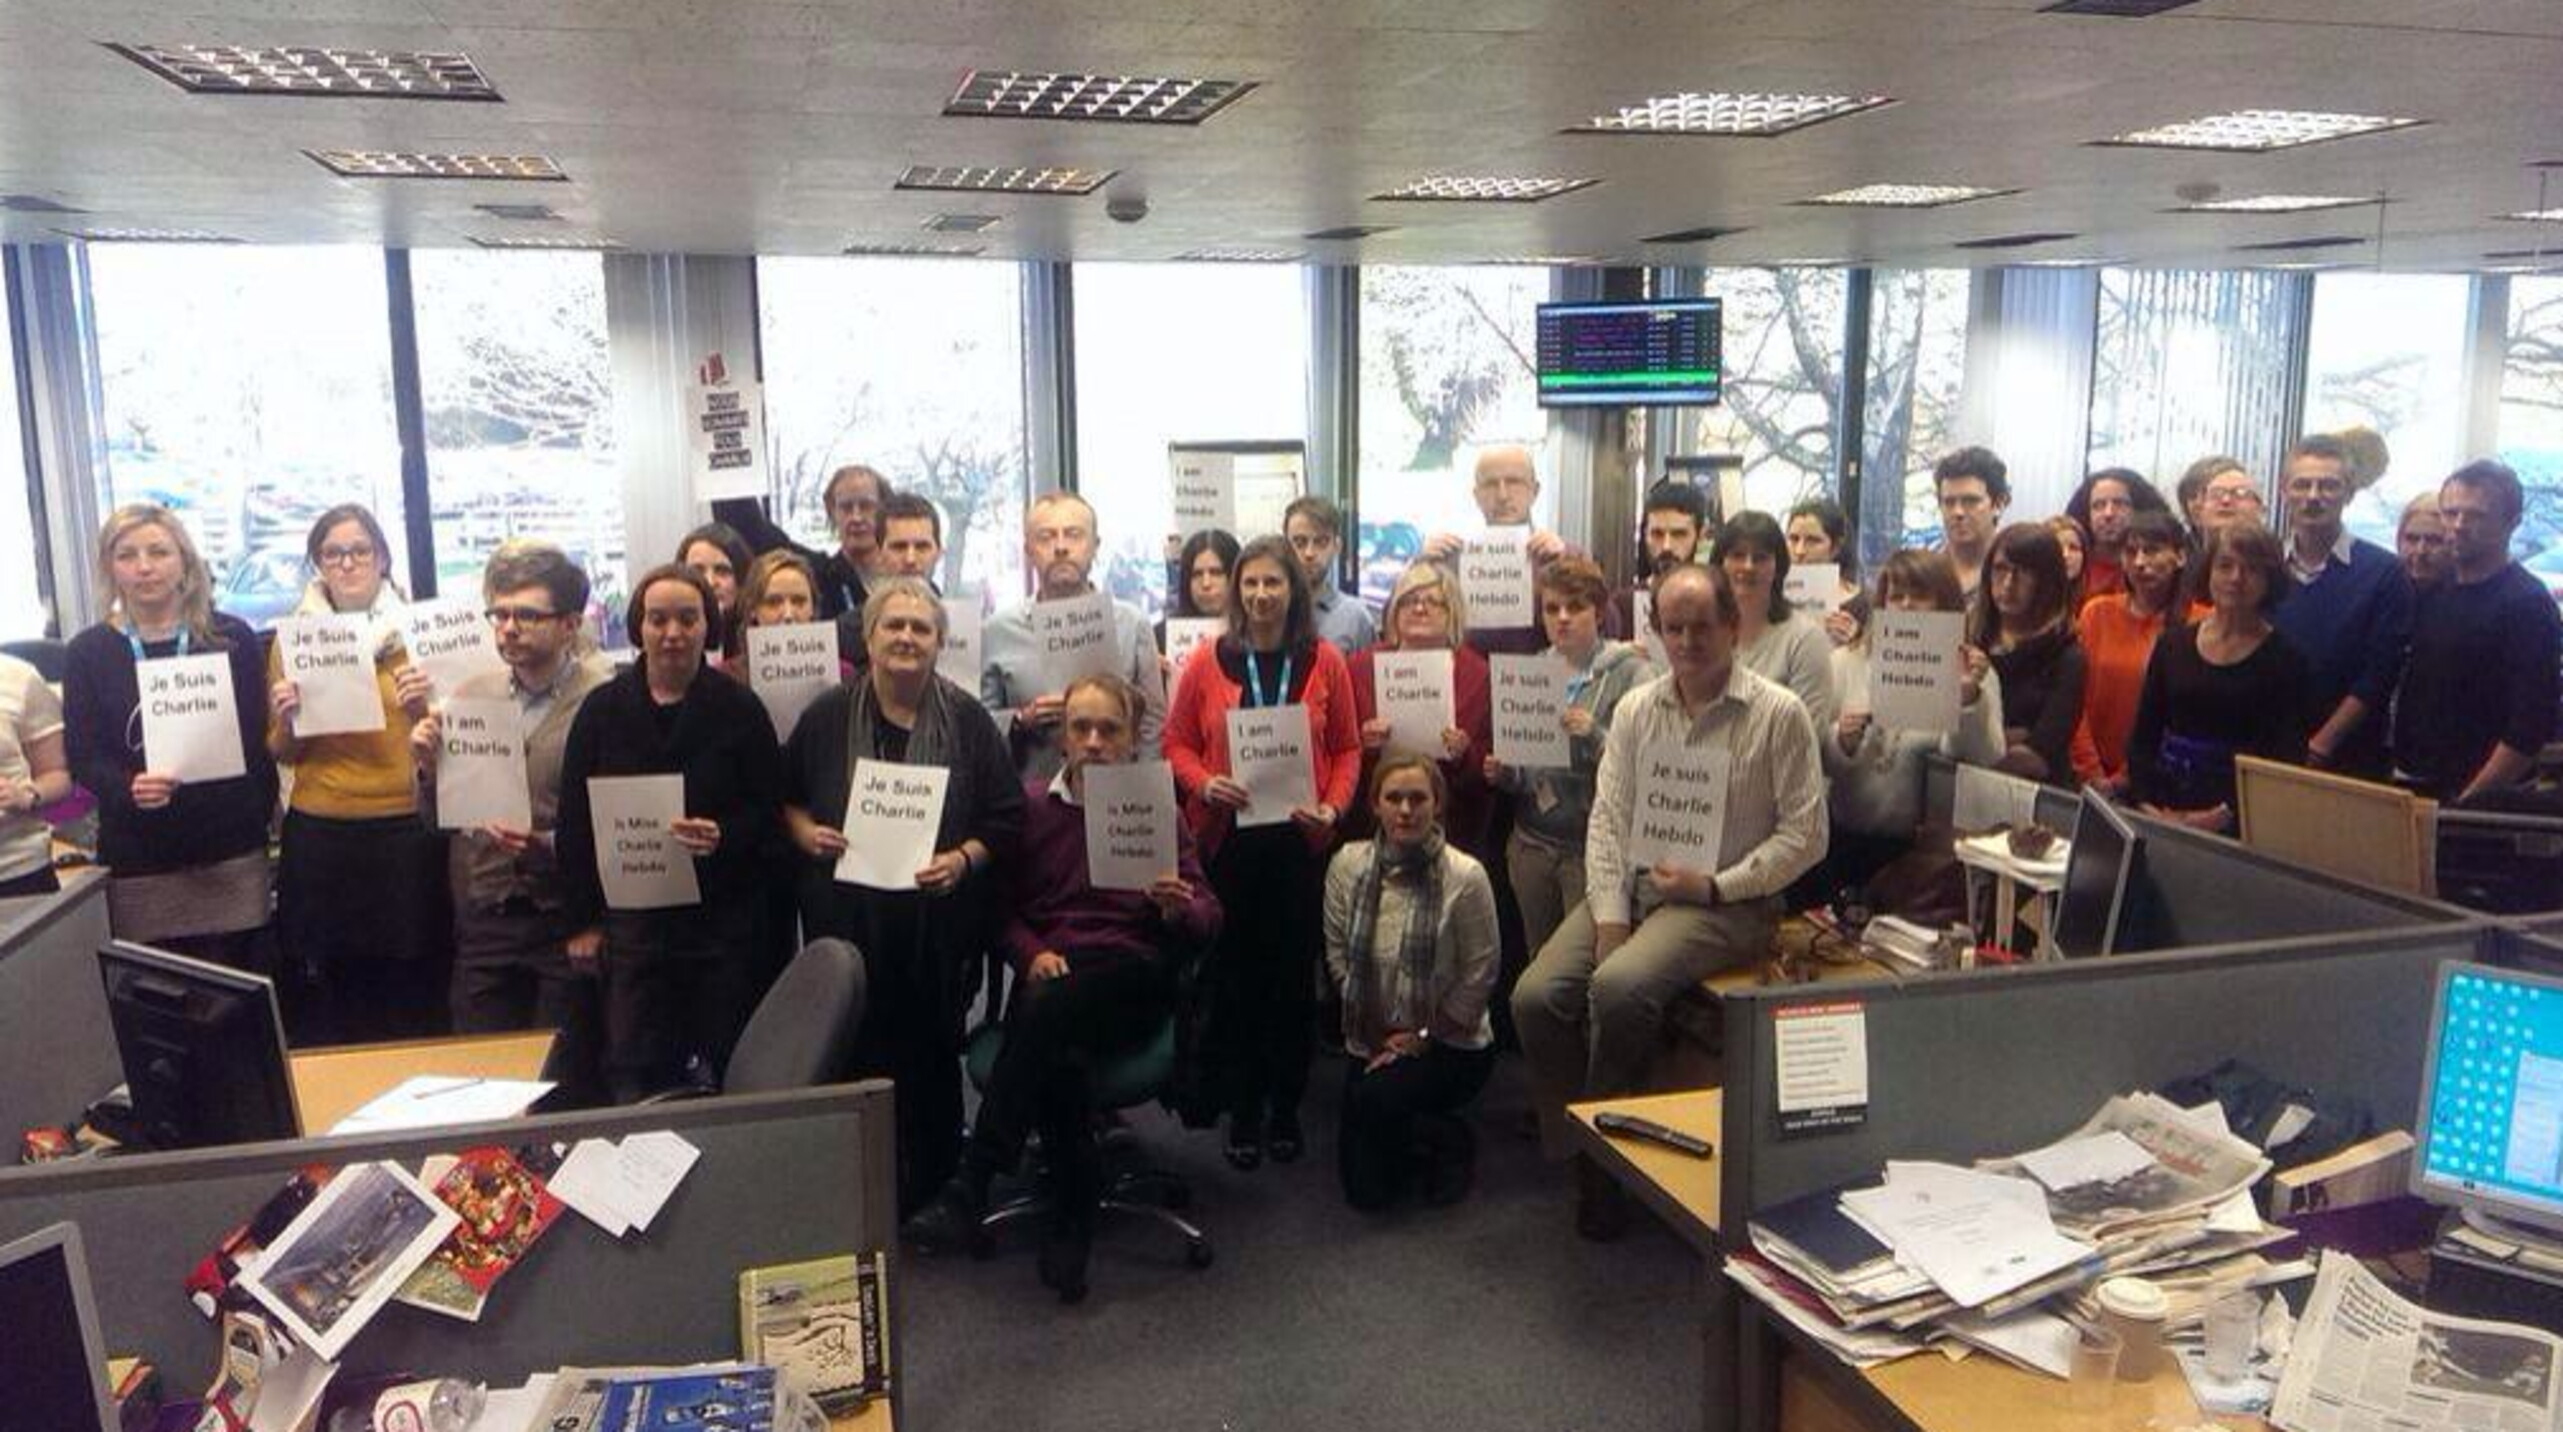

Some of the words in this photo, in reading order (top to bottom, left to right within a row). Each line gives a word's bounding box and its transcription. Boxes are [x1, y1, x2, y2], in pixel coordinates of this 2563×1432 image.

[1183, 466, 1202, 477] am
[1175, 483, 1218, 499] Charlie
[1175, 504, 1216, 517] Hebdo
[1468, 538, 1483, 555] Je
[1488, 540, 1516, 555] suis
[1467, 564, 1522, 581] Charlie
[1469, 591, 1520, 608] Hebdo
[411, 615, 430, 634] Je
[434, 609, 475, 630] Suis
[1043, 614, 1062, 630] Je
[1067, 608, 1103, 628] Suis
[291, 628, 313, 646] Je
[317, 627, 358, 643] Suis
[1048, 628, 1105, 653] Charlie
[1894, 628, 1920, 639] am
[416, 633, 481, 658] Charlie
[760, 641, 781, 657] Je
[786, 638, 827, 655] Suis
[294, 651, 360, 670] Charlie
[1882, 647, 1942, 664] Charlie
[761, 661, 827, 682] Charlie
[1394, 667, 1418, 680] am
[1500, 669, 1515, 687] Je
[1521, 674, 1549, 688] suis
[1881, 671, 1935, 688] Hebdo
[149, 674, 168, 693] Je
[174, 671, 217, 690] Suis
[1386, 686, 1441, 702] Charlie
[152, 697, 218, 717] Charlie
[1501, 698, 1557, 716] Charlie
[459, 717, 486, 731] am
[1248, 724, 1273, 738] am
[1502, 727, 1556, 743] Hebdo
[448, 738, 511, 757] Charlie
[1240, 742, 1299, 761] Charlie
[1652, 760, 1670, 778] Je
[1677, 766, 1710, 784] suis
[865, 776, 887, 792] Je
[893, 779, 932, 797] Suis
[860, 799, 926, 820] Charlie
[1647, 790, 1713, 815] Charlie
[1107, 824, 1156, 839] Charlie
[1643, 822, 1704, 846] Hebdo
[617, 838, 663, 853] Charlie
[1110, 845, 1156, 859] Hebdo
